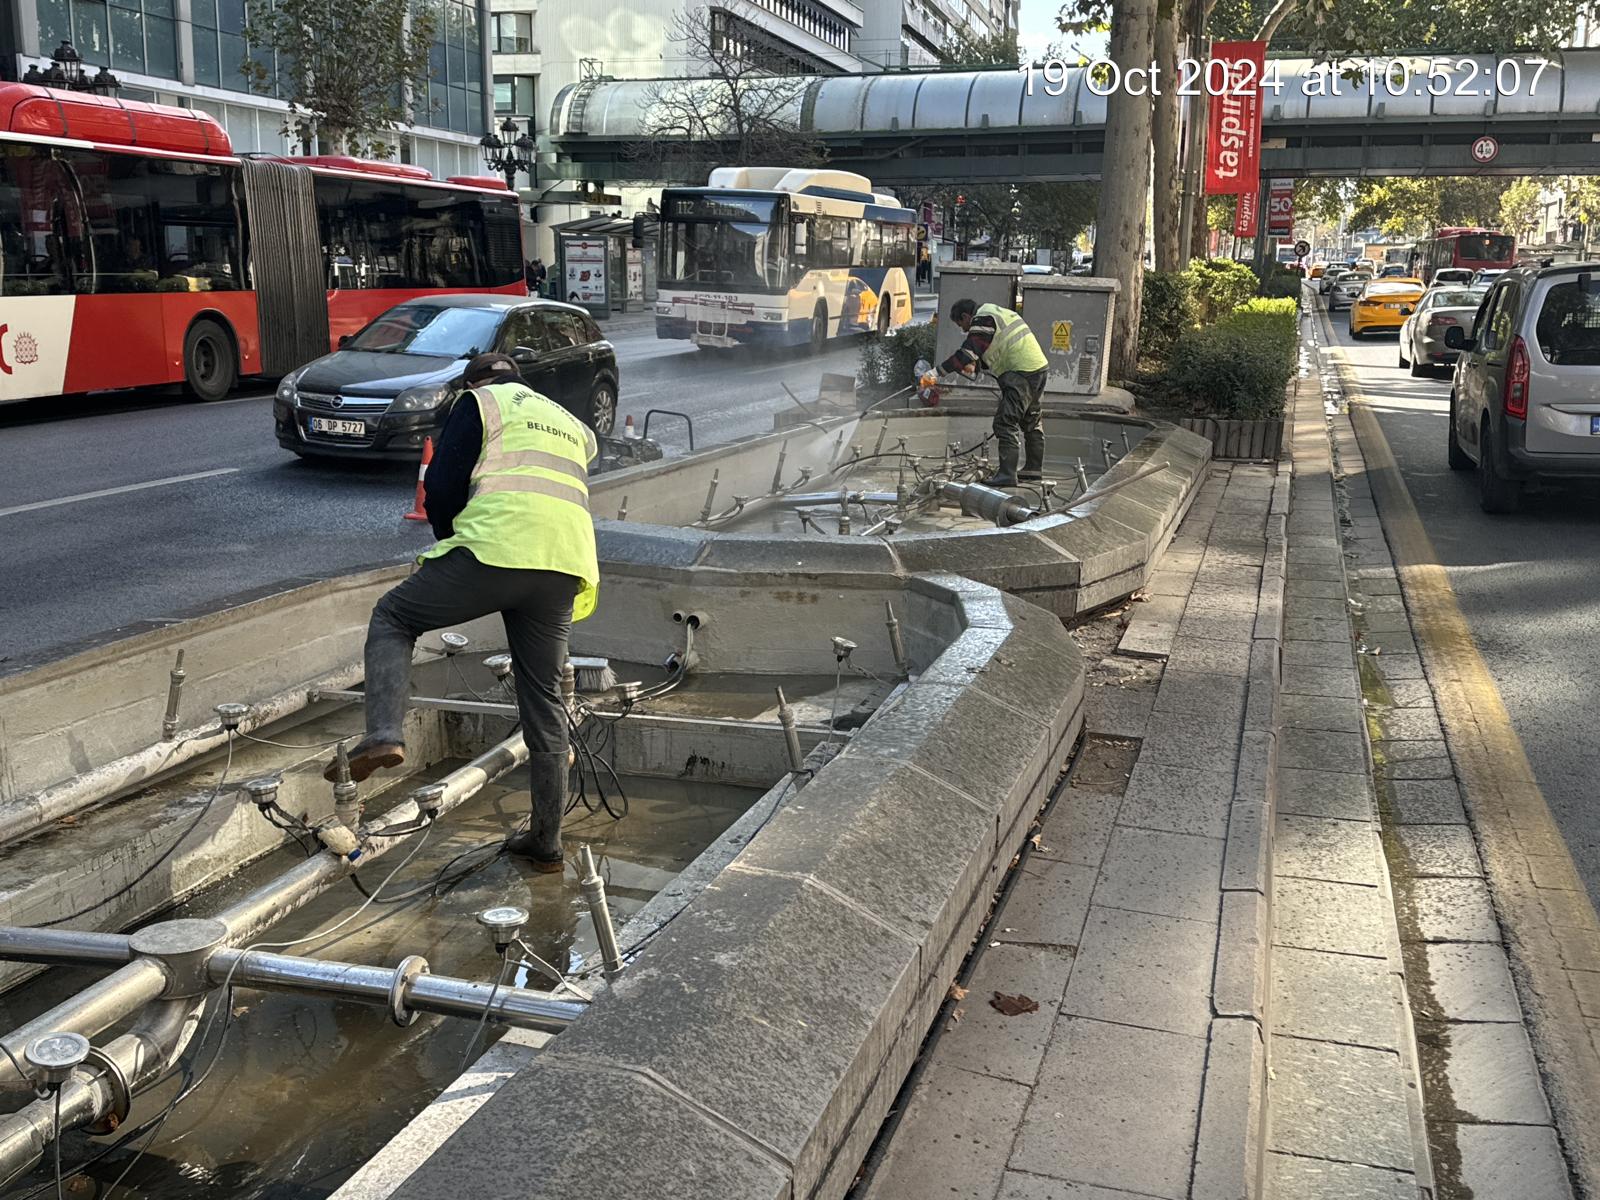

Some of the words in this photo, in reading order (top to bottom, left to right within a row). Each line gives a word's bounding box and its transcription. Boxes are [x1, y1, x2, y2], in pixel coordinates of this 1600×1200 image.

[1477, 143, 1484, 155] 4
[677, 201, 695, 215] 112
[1271, 197, 1292, 212] 50
[327, 420, 338, 431] DP
[341, 421, 363, 433] 5727
